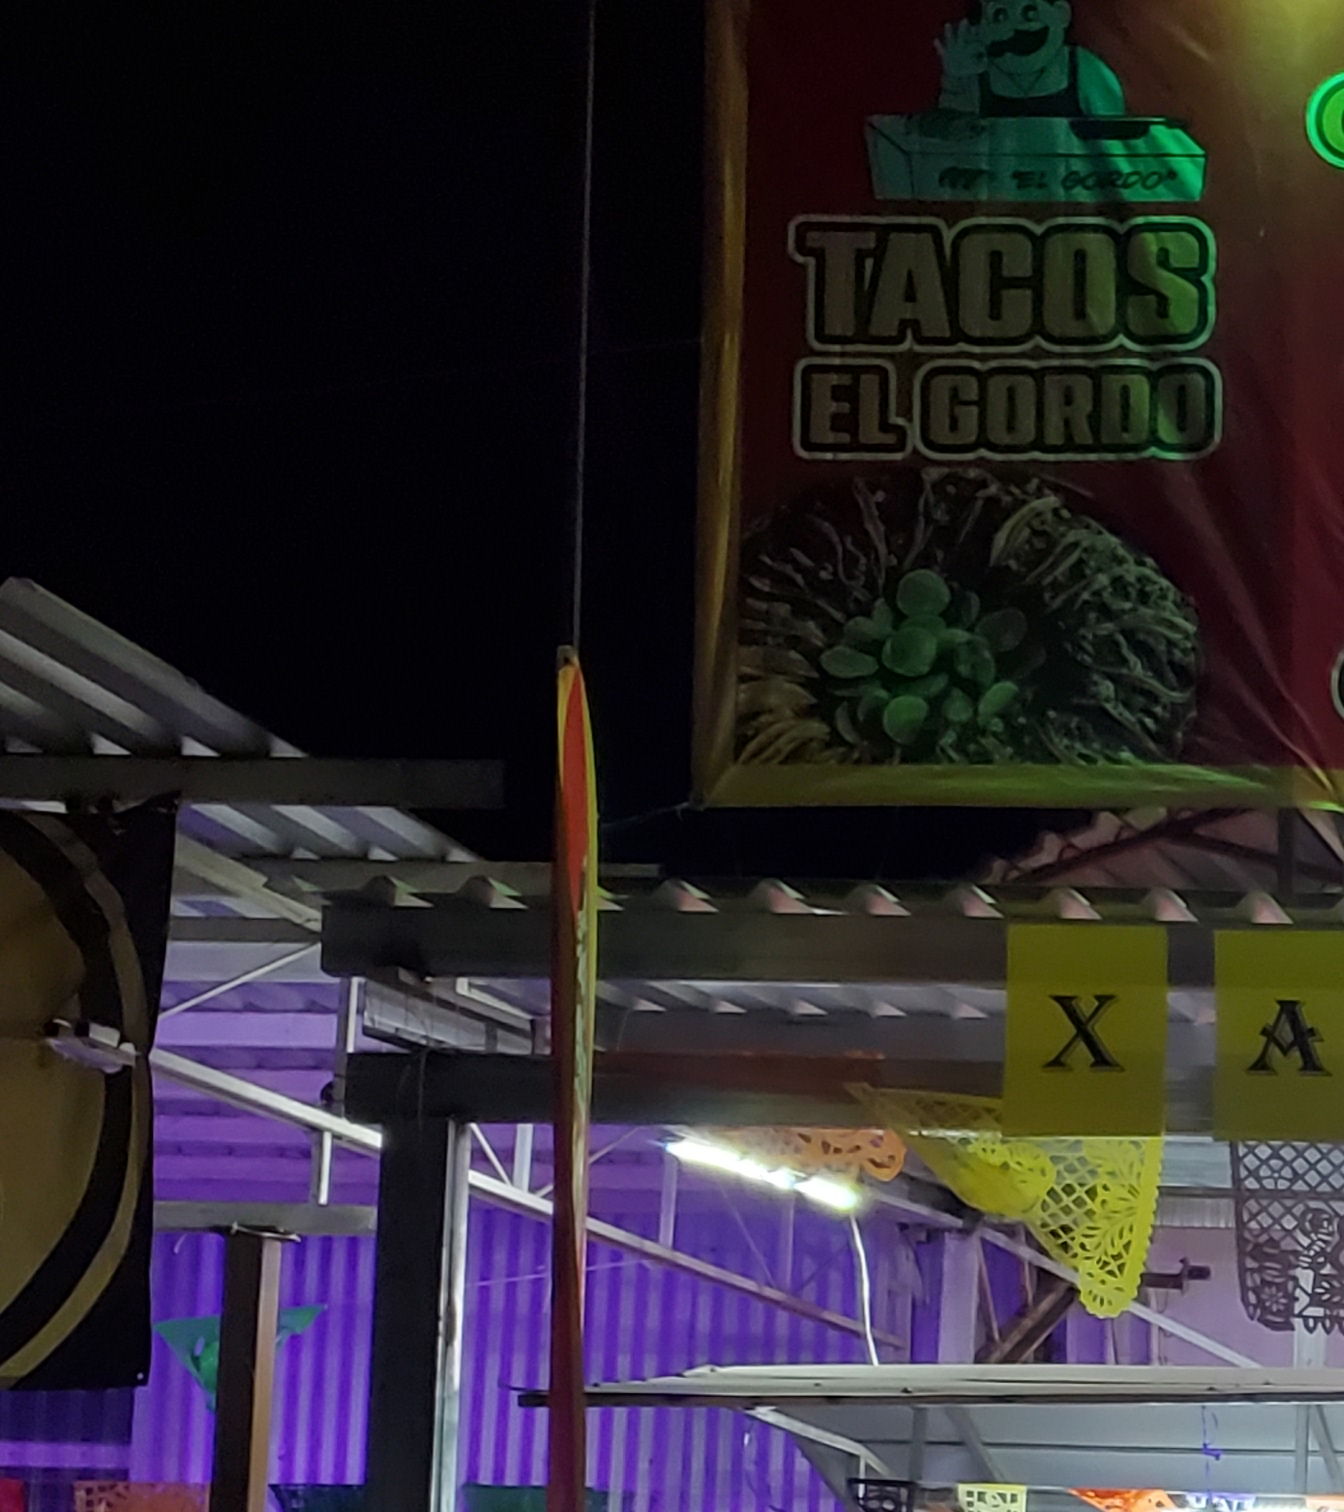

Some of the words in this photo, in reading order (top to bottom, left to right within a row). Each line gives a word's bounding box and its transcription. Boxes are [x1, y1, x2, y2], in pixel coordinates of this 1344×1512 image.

[795, 222, 1210, 346] TACOS
[801, 364, 903, 453] EL
[920, 363, 1215, 455] GORDO
